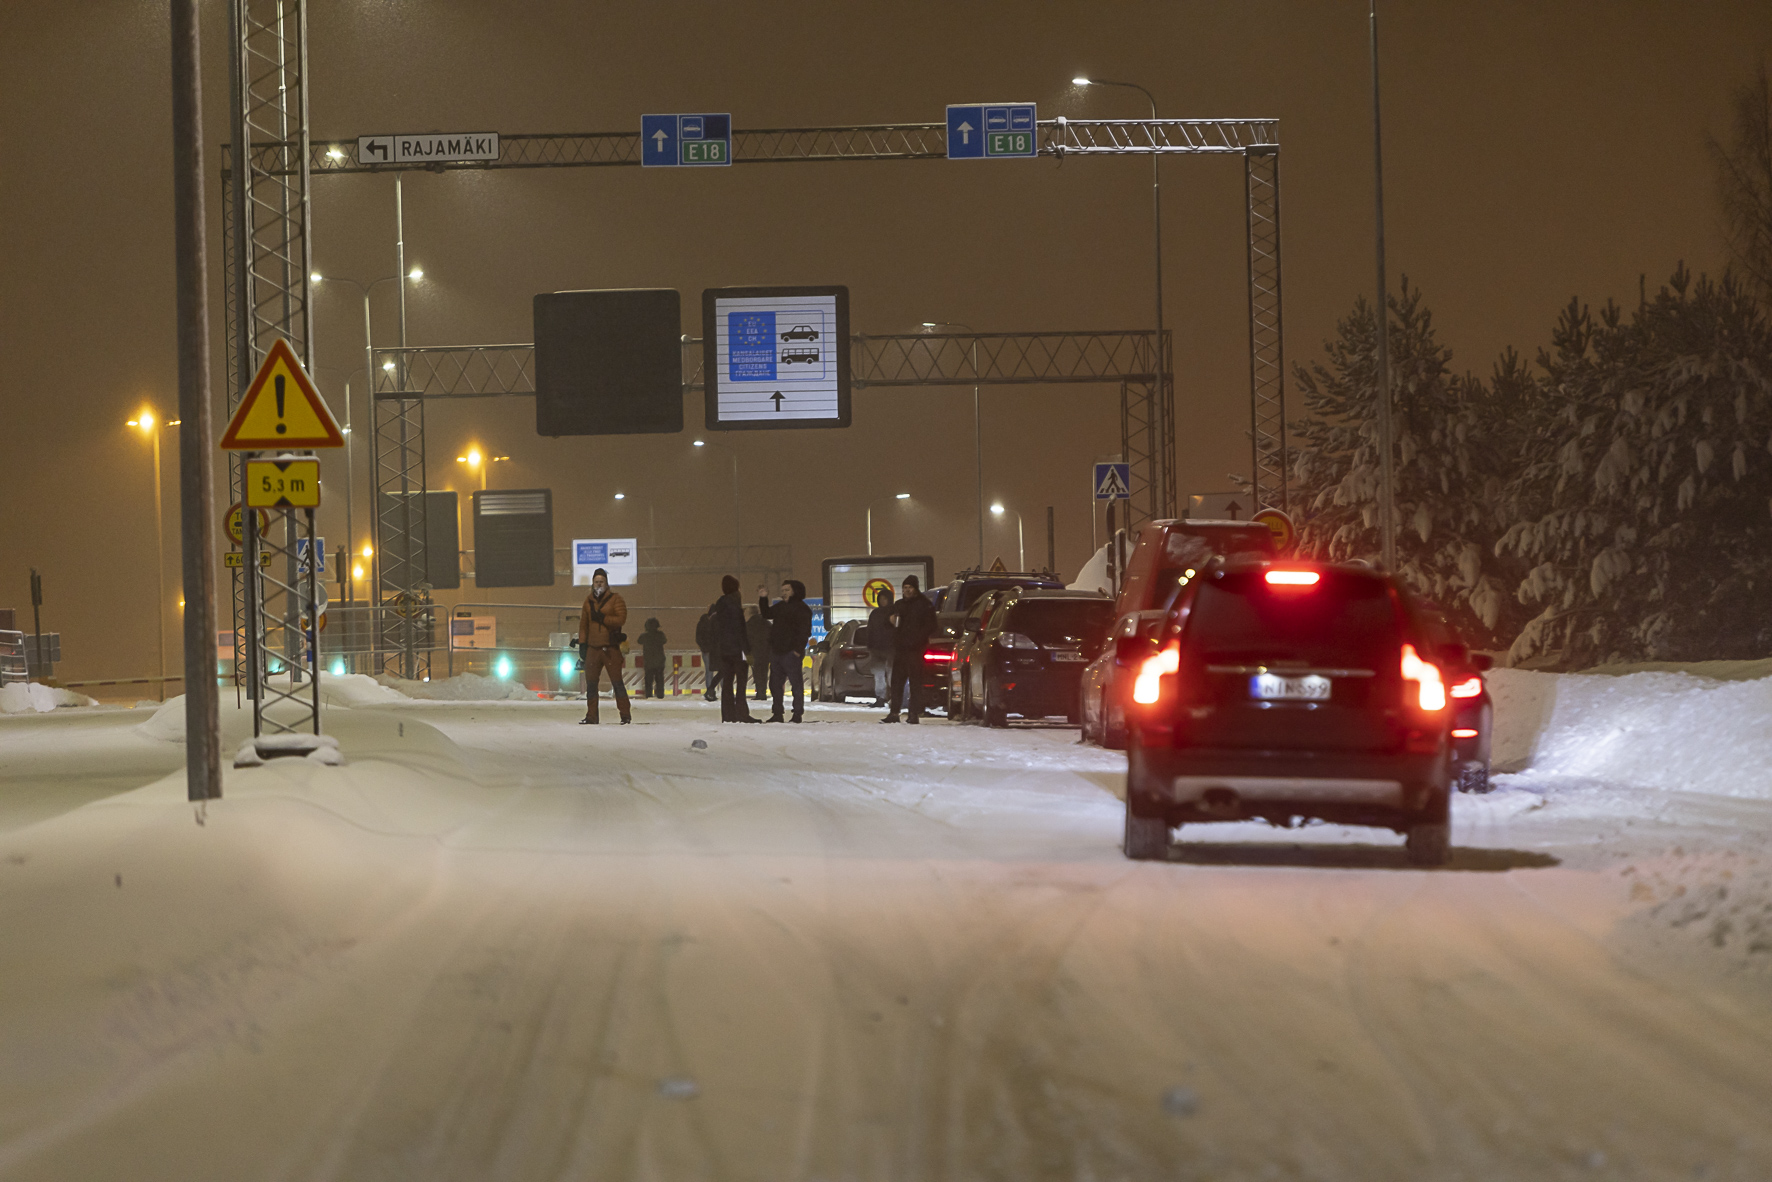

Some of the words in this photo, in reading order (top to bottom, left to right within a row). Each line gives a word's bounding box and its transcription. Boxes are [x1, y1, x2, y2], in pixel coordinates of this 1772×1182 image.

[402, 136, 492, 156] RAJAMÄKI
[995, 135, 1025, 151] E18
[689, 144, 720, 160] E18
[290, 479, 305, 492] m
